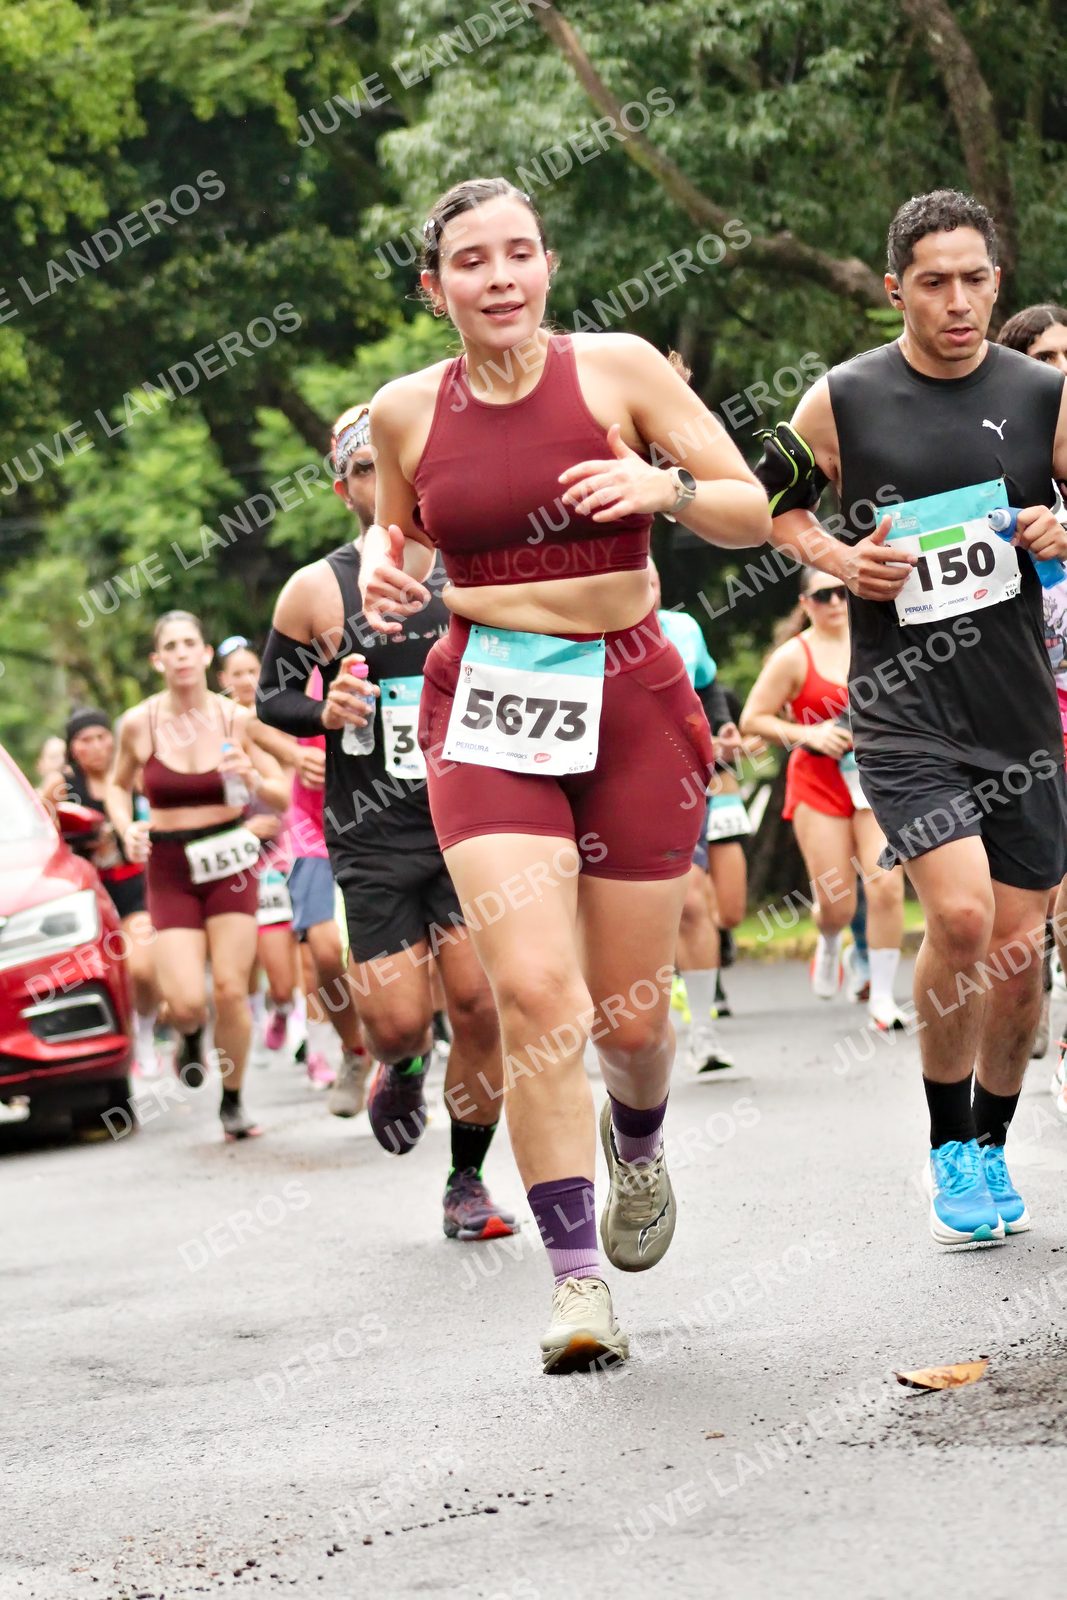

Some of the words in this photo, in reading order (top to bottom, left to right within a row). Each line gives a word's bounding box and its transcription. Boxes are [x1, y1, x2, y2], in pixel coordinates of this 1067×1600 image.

[453, 538, 619, 582] SAUCONY
[916, 541, 996, 593] 150
[904, 604, 933, 614] PERDURA
[460, 687, 588, 742] 5673
